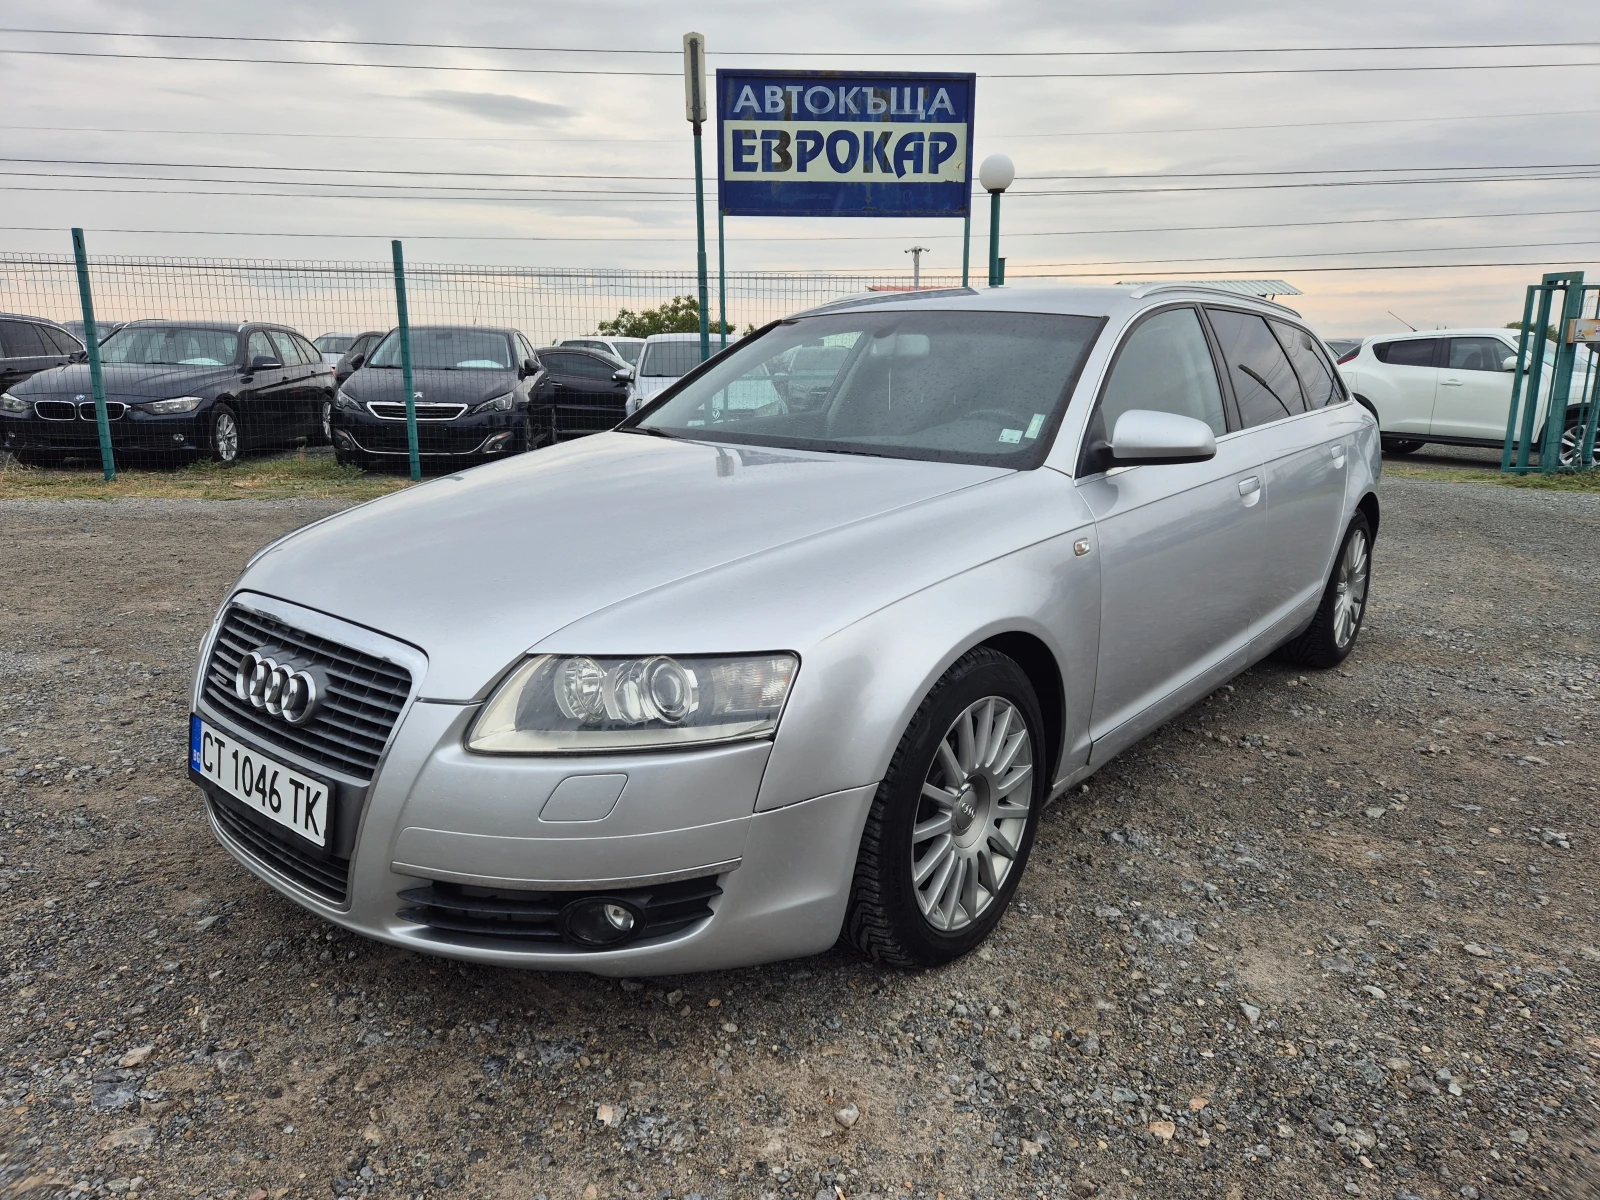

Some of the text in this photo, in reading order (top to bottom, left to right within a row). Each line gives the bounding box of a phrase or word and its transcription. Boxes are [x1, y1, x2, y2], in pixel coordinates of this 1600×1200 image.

[733, 85, 956, 120] АВТОКЪЩА
[732, 129, 958, 179] ЕВРОКАР
[202, 731, 322, 836] CT 1046 TK
